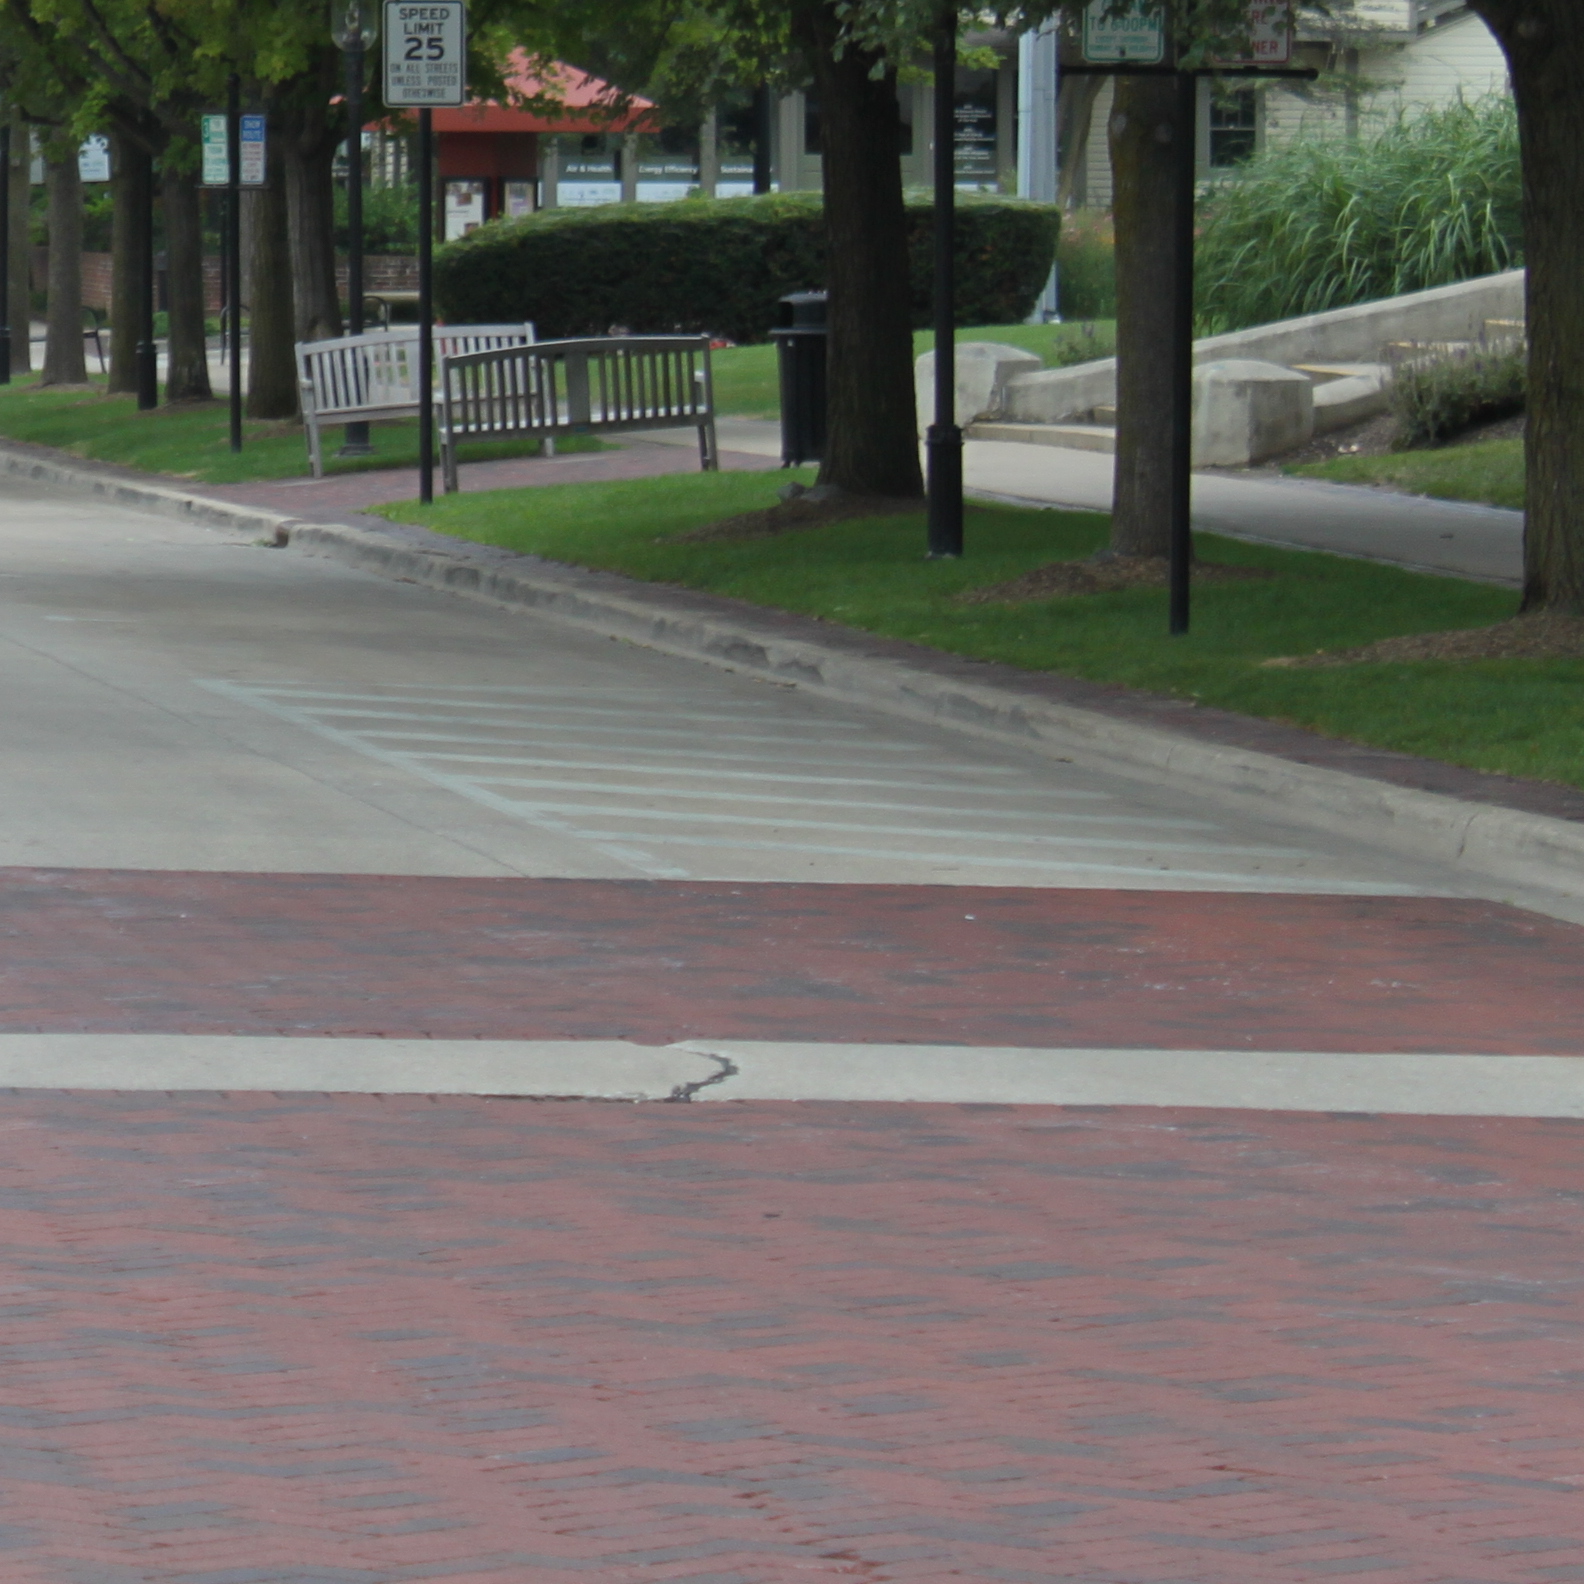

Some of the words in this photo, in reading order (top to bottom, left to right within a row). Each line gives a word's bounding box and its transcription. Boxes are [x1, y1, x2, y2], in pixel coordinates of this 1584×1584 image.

[399, 8, 450, 20] SPEED
[404, 22, 444, 35] LIMIT
[404, 37, 444, 61] 25
[390, 63, 401, 73] ON
[406, 64, 420, 74] ALL
[425, 63, 458, 74] STREETS
